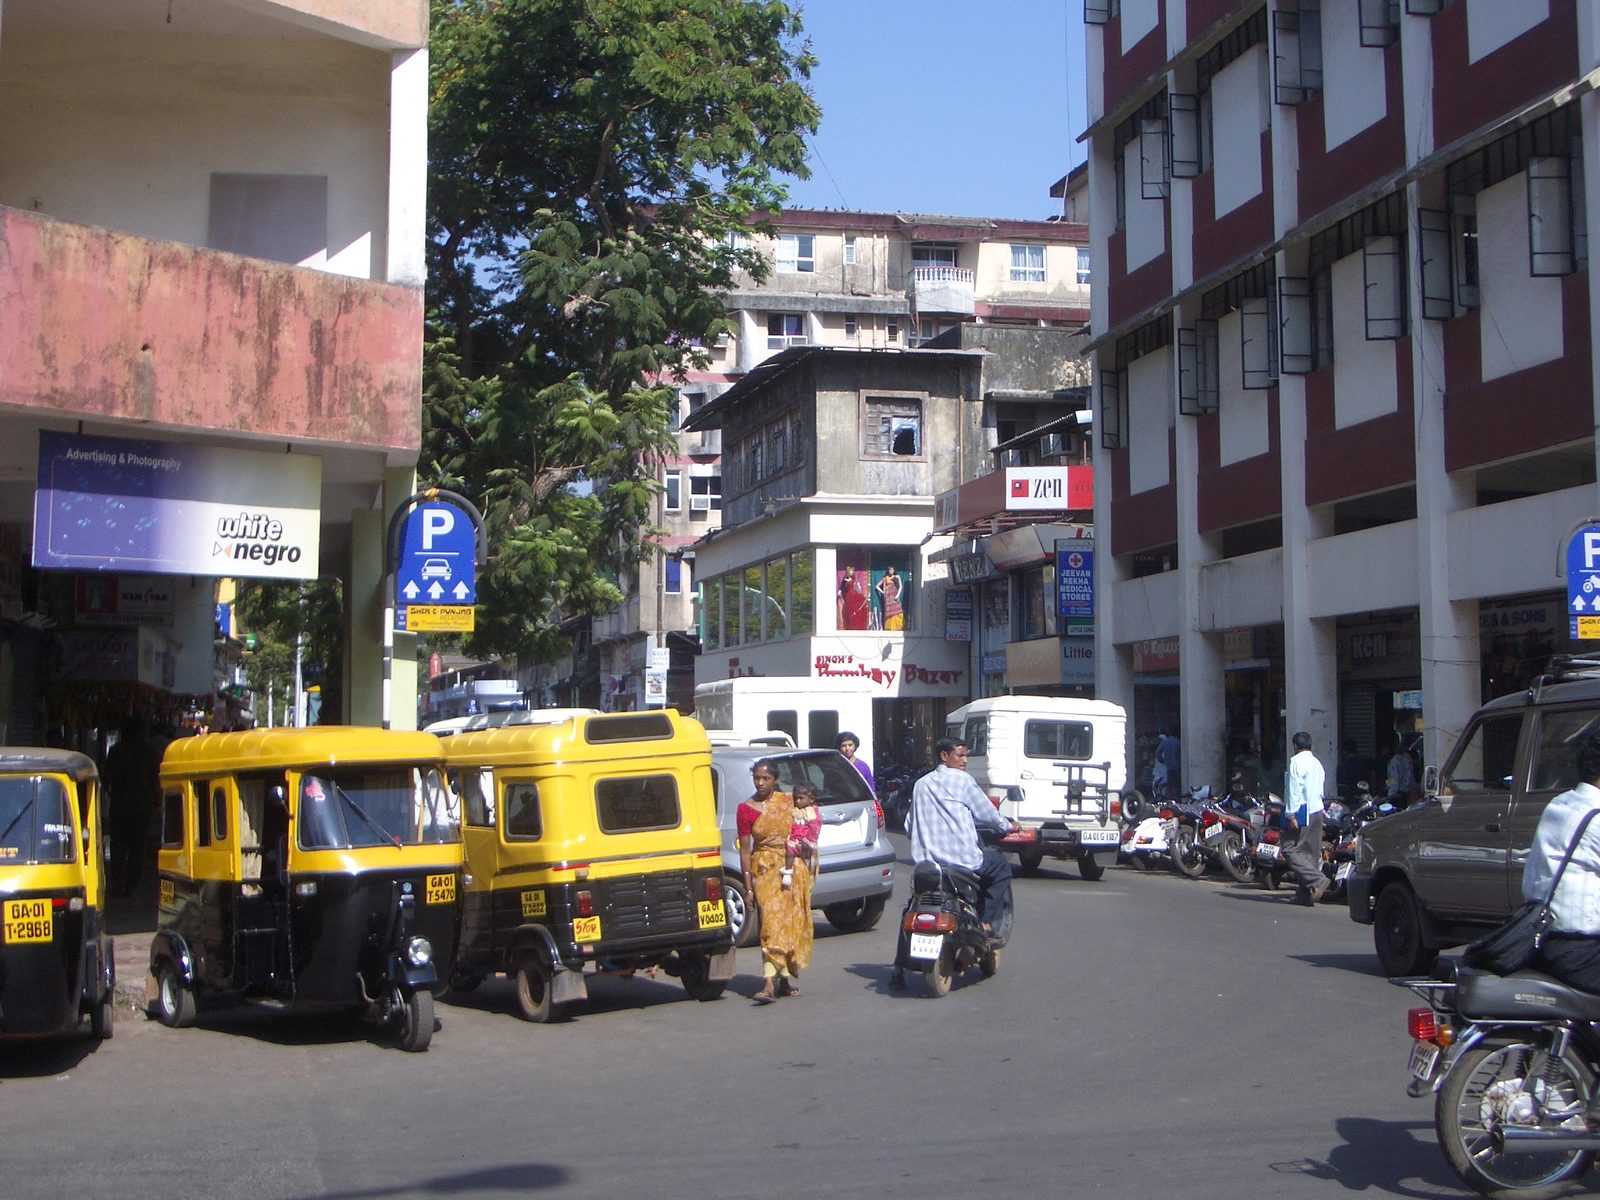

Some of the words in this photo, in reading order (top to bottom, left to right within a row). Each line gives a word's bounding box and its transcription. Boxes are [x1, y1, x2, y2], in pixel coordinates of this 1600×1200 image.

[66, 447, 117, 465] Advertising
[119, 452, 125, 464] &
[127, 453, 181, 471] Photography
[1033, 478, 1062, 499] zen
[217, 512, 283, 541] white
[423, 509, 454, 550] P
[234, 542, 301, 566] negro
[1061, 569, 1091, 577] JEEVAN
[1063, 577, 1089, 585] REKHA
[1060, 585, 1092, 593] MEDICAL
[1061, 593, 1091, 601] STORES
[816, 655, 854, 665] SINGH'S
[902, 664, 963, 684] Bazar
